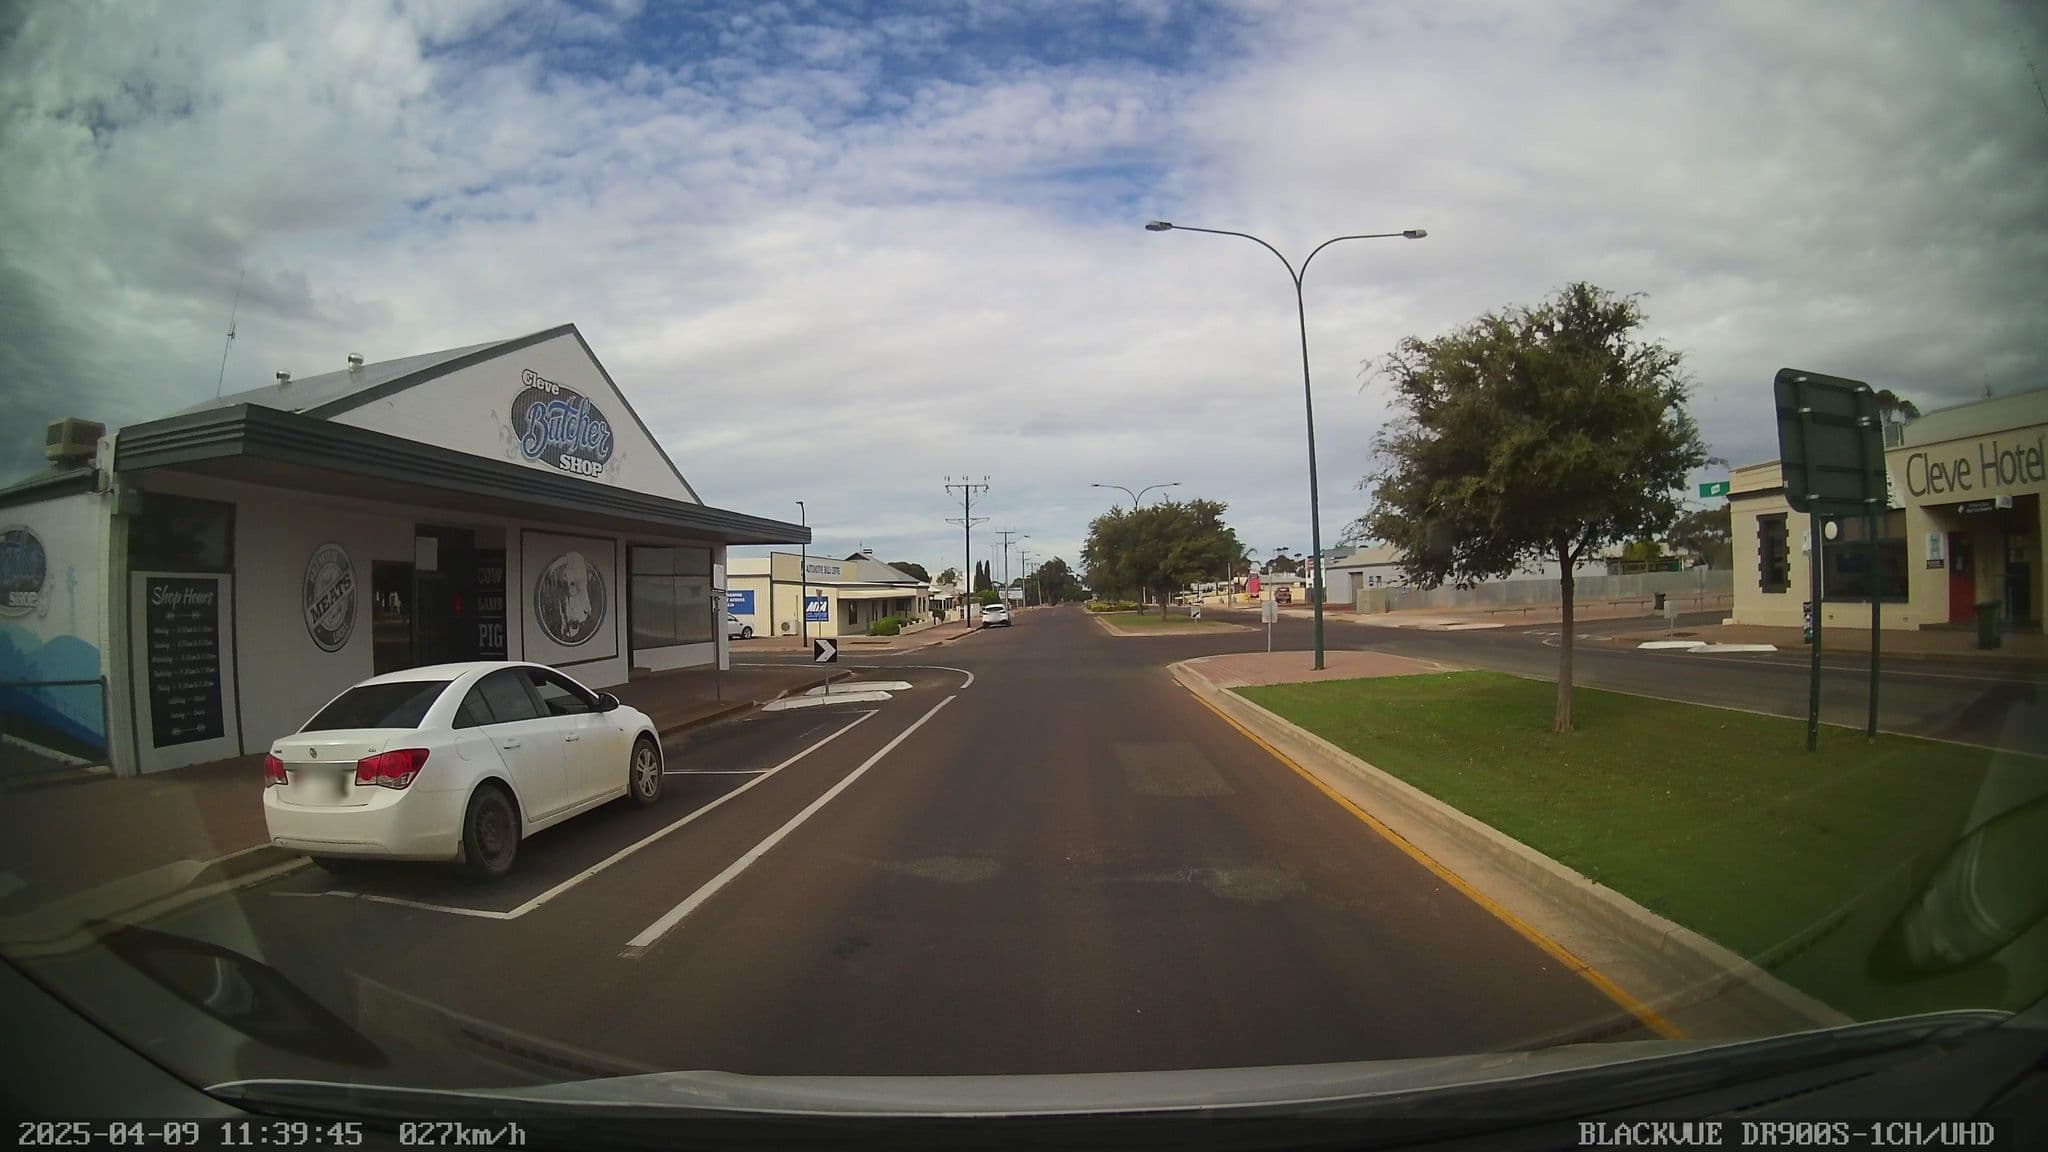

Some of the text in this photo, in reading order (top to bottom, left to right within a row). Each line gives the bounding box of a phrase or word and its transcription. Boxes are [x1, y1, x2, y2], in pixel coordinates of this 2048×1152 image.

[521, 368, 560, 395] Cleve
[521, 396, 611, 460] Butcher
[559, 454, 603, 478] SHOP
[1906, 437, 2046, 497] Cleve Hotel
[8, 591, 38, 607] SHOP
[152, 585, 214, 610] Shop Hours
[310, 574, 352, 625] MEATS
[479, 624, 503, 648] PIG
